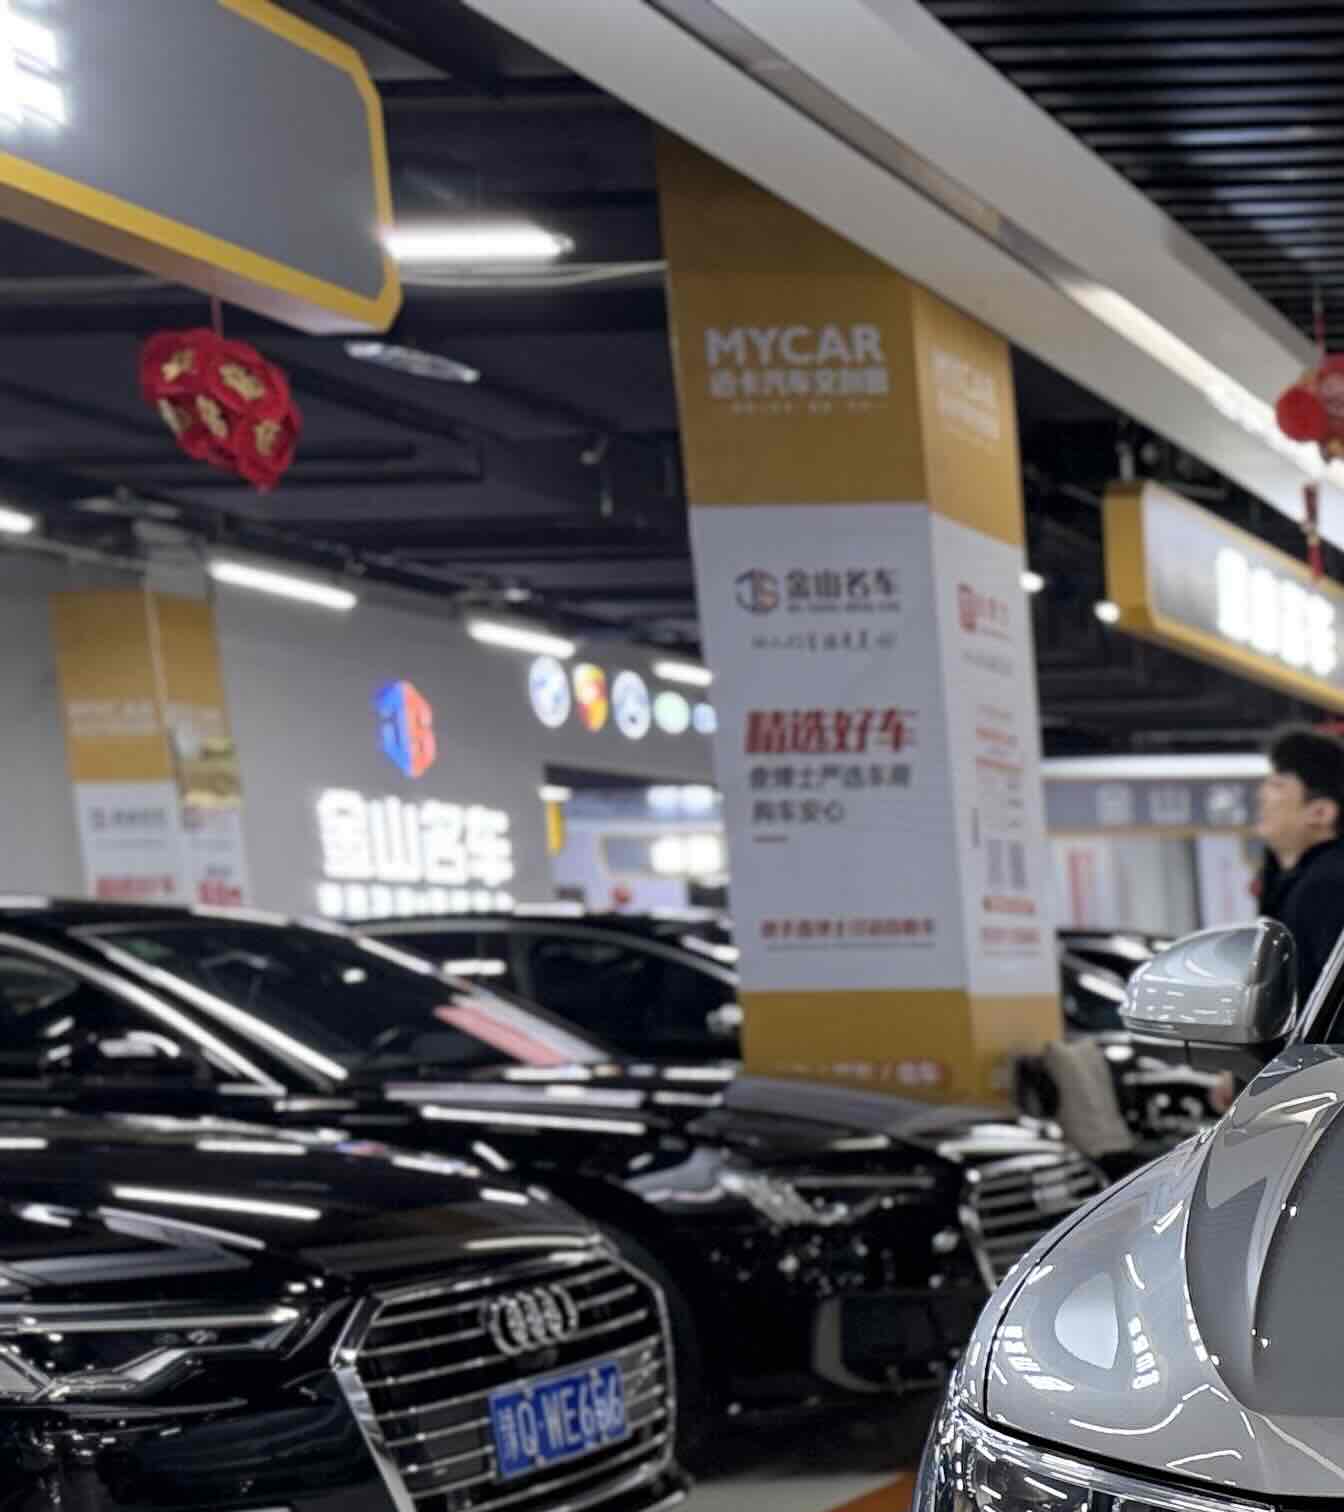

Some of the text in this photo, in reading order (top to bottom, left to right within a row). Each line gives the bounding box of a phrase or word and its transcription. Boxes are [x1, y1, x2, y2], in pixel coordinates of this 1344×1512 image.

[704, 323, 885, 368] MYCAR
[784, 567, 897, 599] 金山名车
[745, 707, 917, 756] 精选好车
[317, 787, 514, 888] 金山名车
